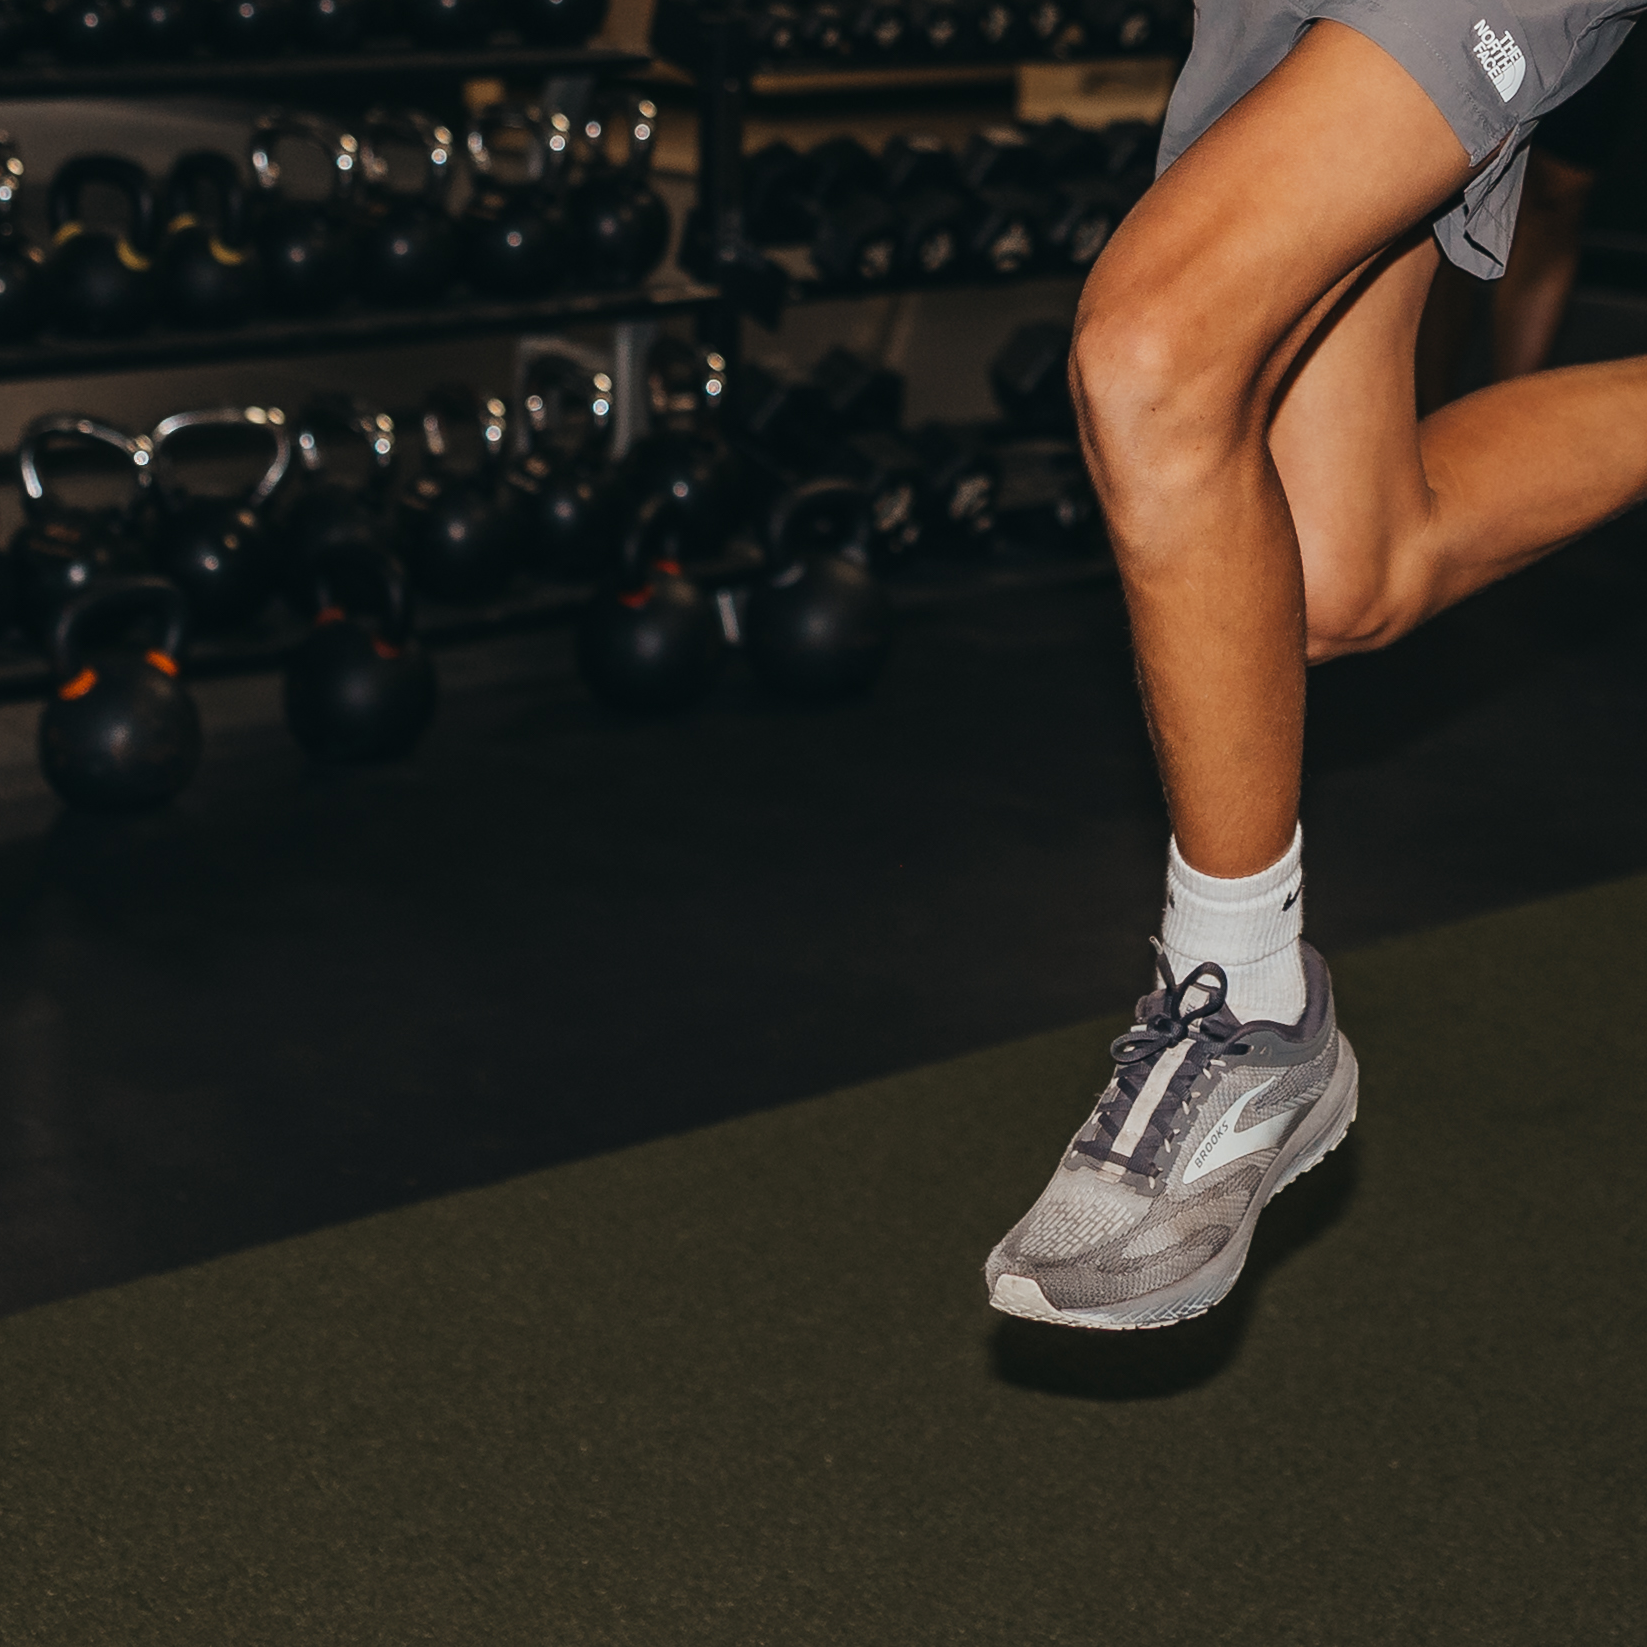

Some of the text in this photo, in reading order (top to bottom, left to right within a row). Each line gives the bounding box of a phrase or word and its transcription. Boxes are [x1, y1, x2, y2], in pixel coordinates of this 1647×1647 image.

[1472, 42, 1503, 81] FACE
[1473, 19, 1514, 72] NORTH
[1499, 30, 1524, 62] THE
[1194, 1120, 1229, 1169] BROOKS
